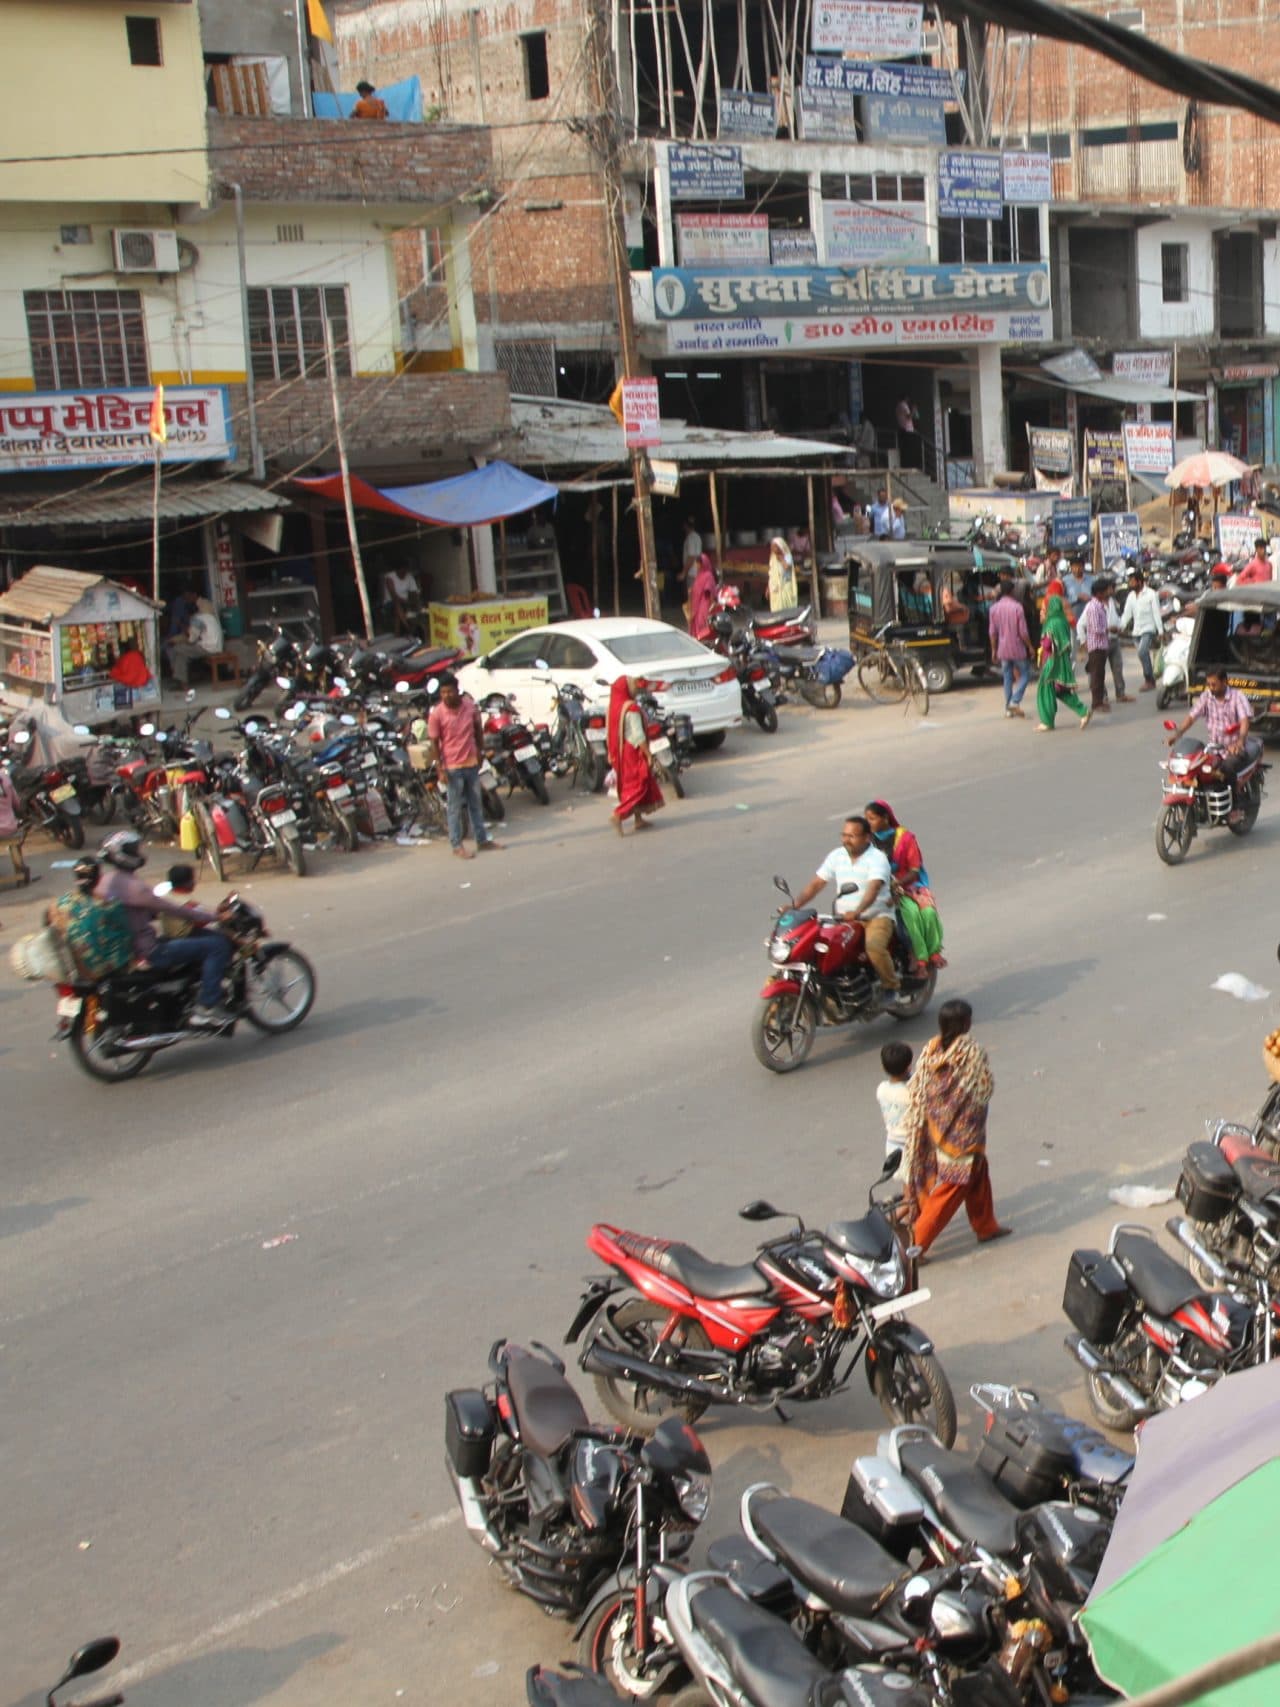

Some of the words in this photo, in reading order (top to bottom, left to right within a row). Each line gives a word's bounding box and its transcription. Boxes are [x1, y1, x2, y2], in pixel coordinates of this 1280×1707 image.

[694, 276, 812, 313] सुरक्षा
[826, 266, 936, 301] नर्सिंग
[950, 267, 1018, 298] होम
[0, 407, 62, 437] प्पू
